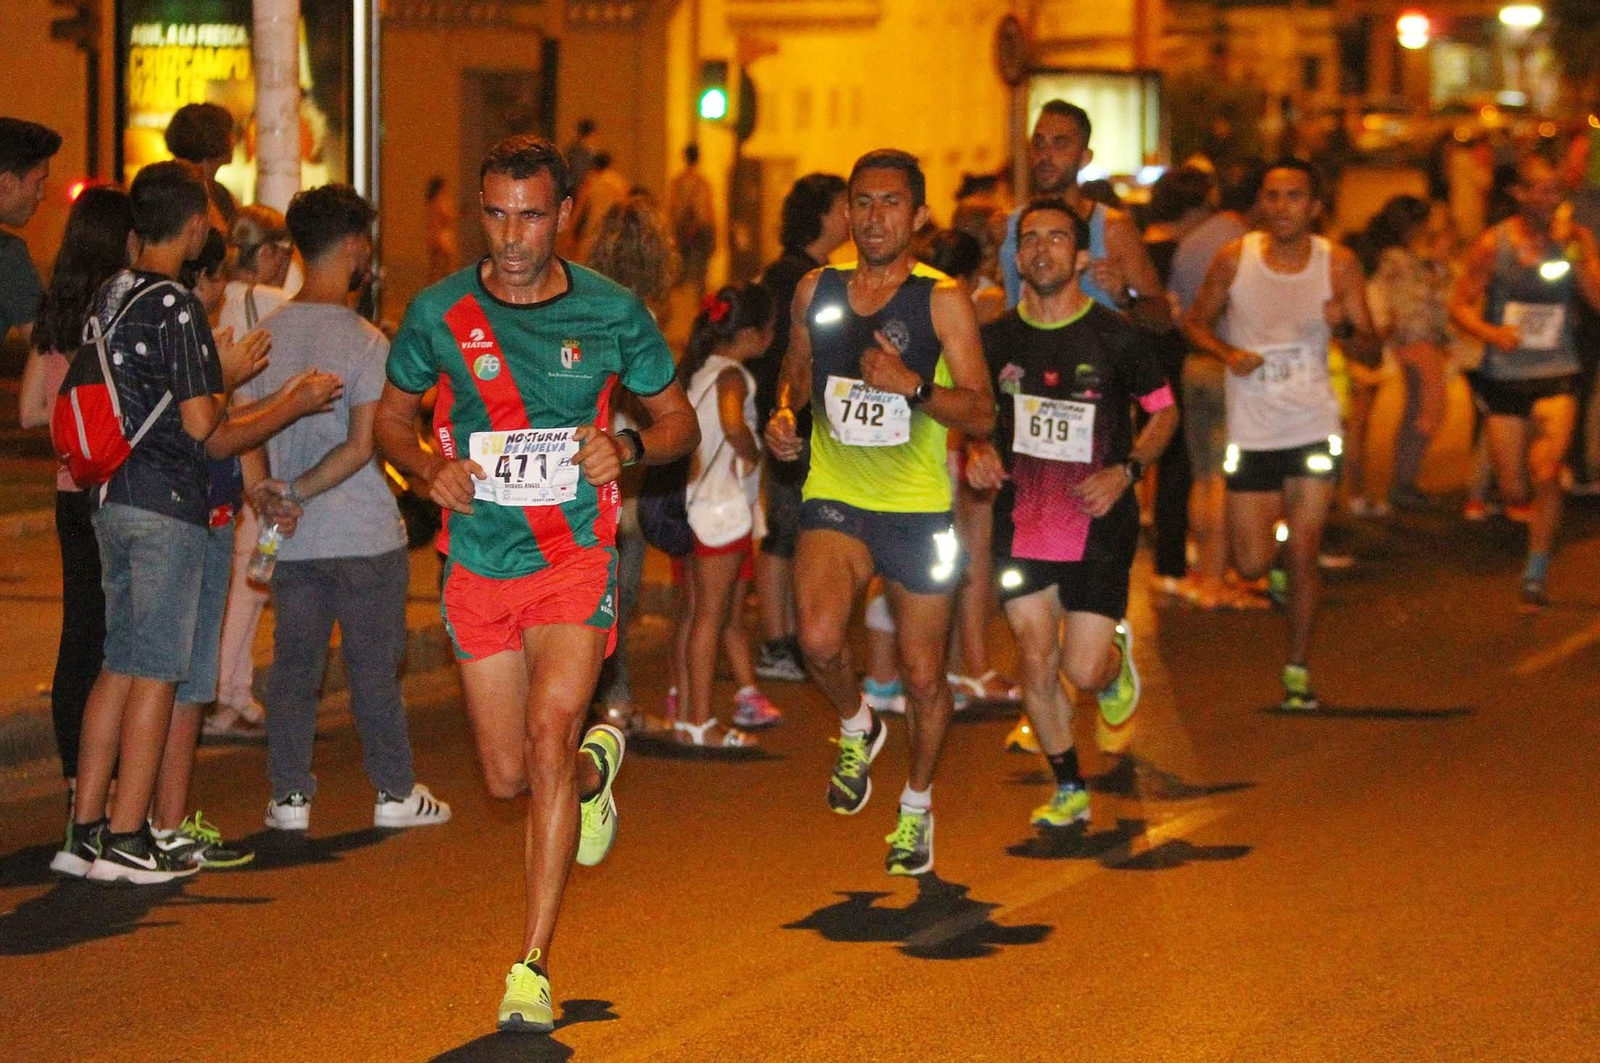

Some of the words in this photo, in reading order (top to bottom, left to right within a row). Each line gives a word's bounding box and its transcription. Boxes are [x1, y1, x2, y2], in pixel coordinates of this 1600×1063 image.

[461, 341, 493, 349] VIATOR
[841, 399, 884, 427] 742
[505, 432, 568, 443] NOCTURNA
[1030, 415, 1069, 442] 619
[438, 426, 454, 459] JAVIER
[503, 444, 519, 454] DE
[522, 443, 566, 453] HUELVA
[494, 454, 547, 483] 471
